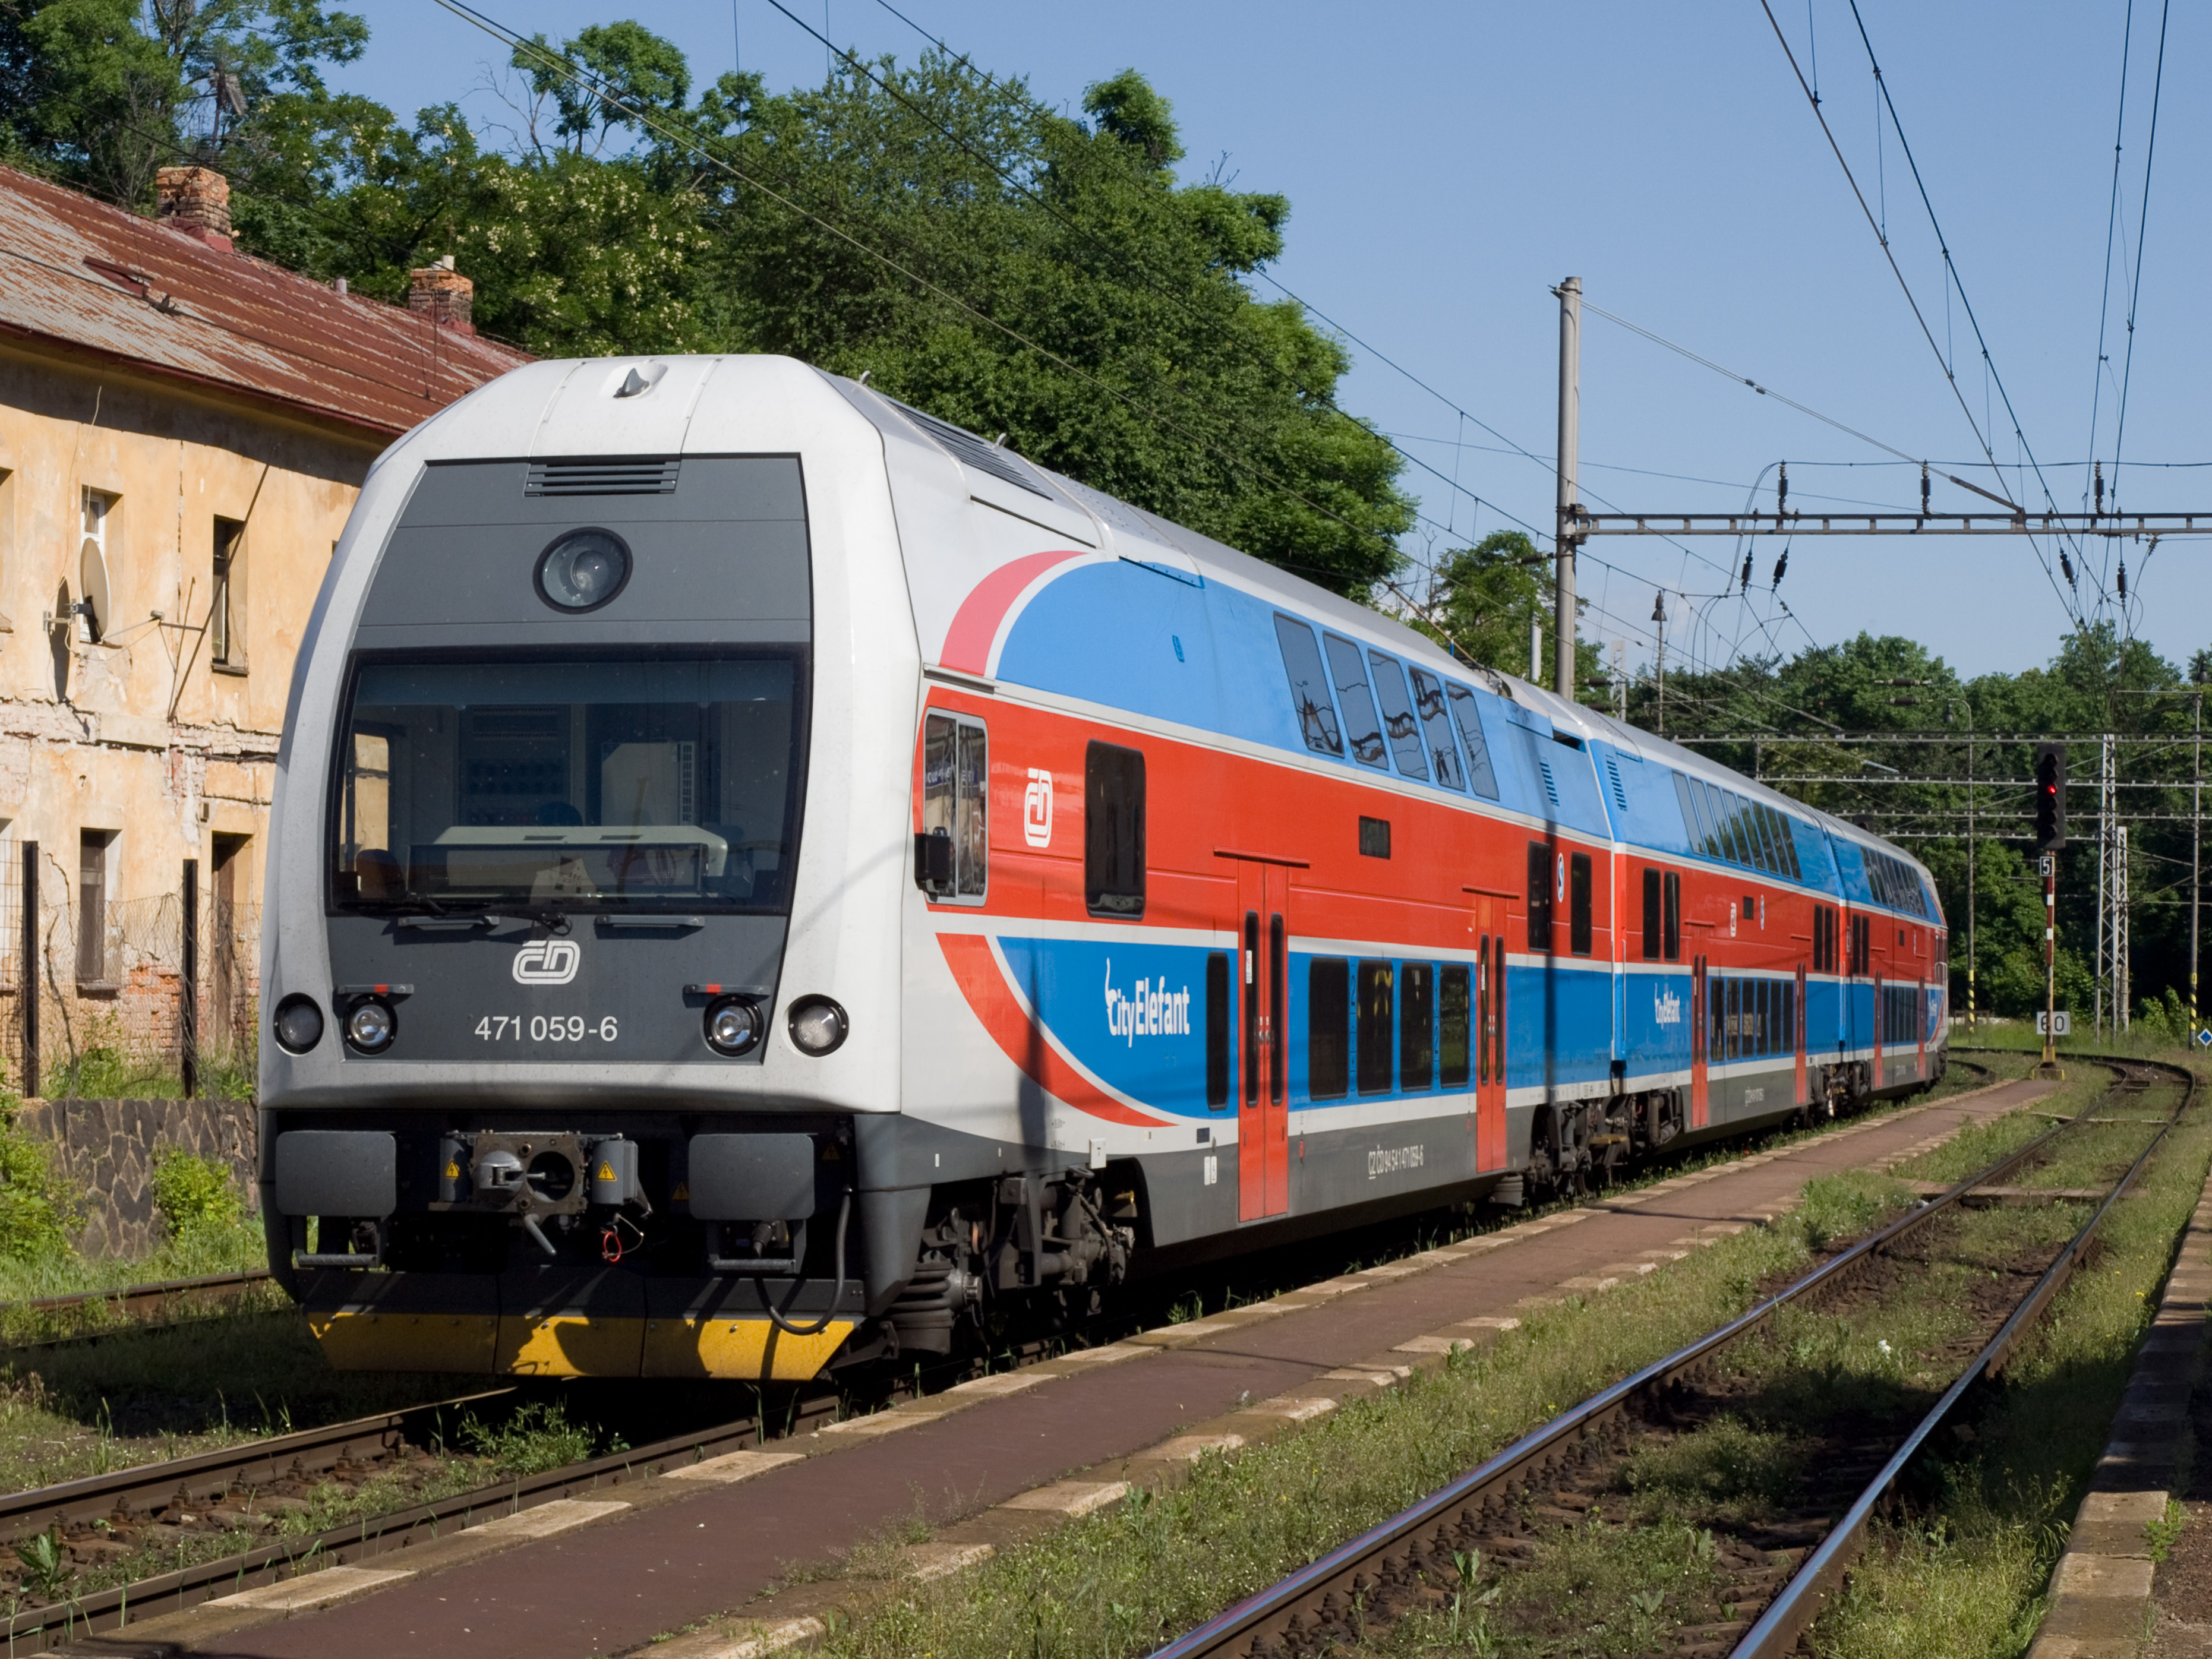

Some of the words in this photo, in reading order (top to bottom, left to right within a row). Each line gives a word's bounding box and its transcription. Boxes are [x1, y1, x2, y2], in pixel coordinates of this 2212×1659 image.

[2043, 858, 2050, 874] 5
[475, 1016, 520, 1041] 471
[530, 1016, 618, 1041] 059-6
